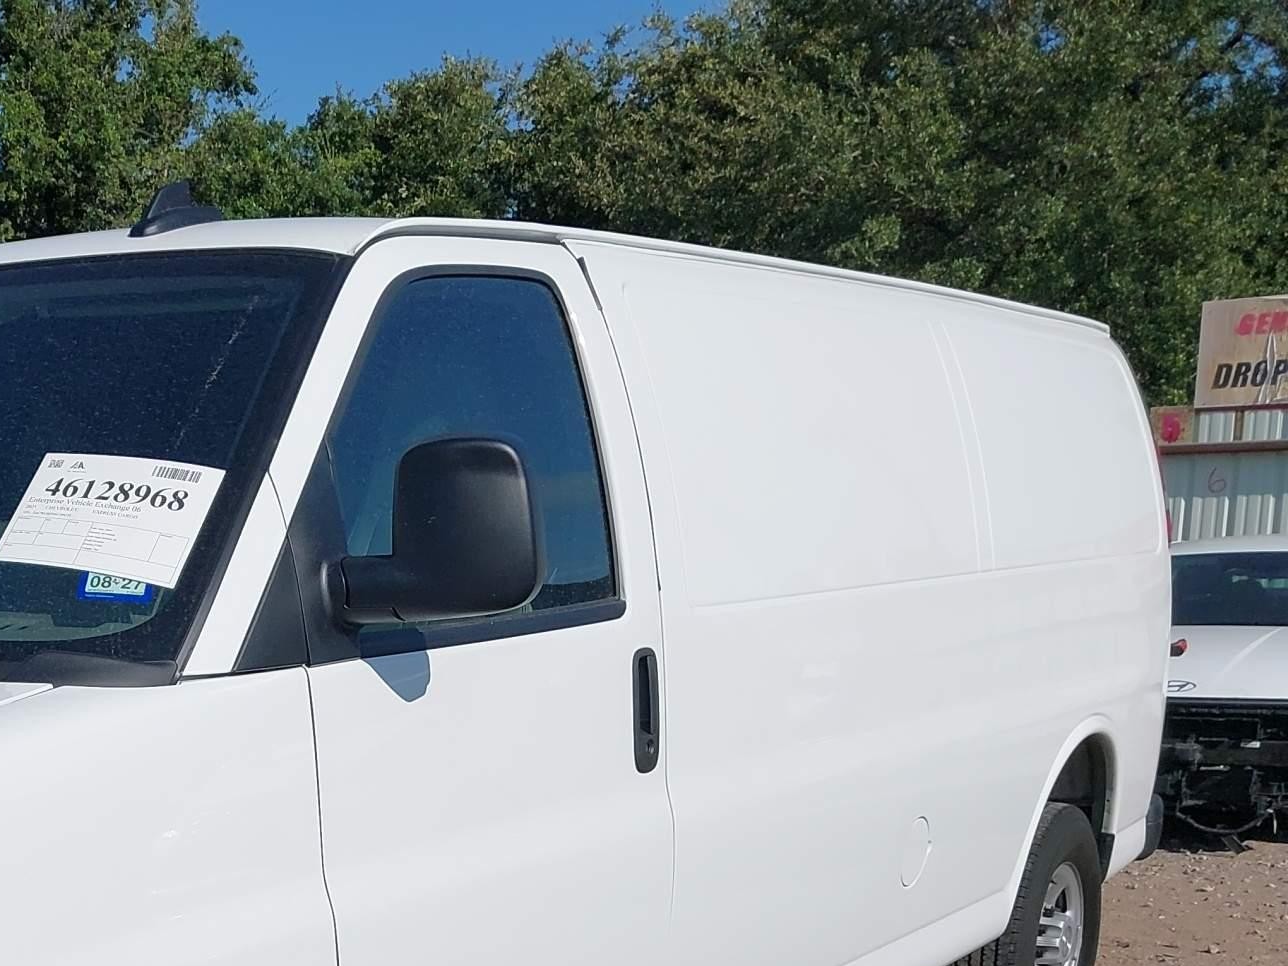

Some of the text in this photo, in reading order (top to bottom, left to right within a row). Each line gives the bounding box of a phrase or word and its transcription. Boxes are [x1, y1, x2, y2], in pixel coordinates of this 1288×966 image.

[1211, 360, 1288, 389] DROP
[44, 477, 189, 512] 46128968
[90, 575, 112, 589] 08
